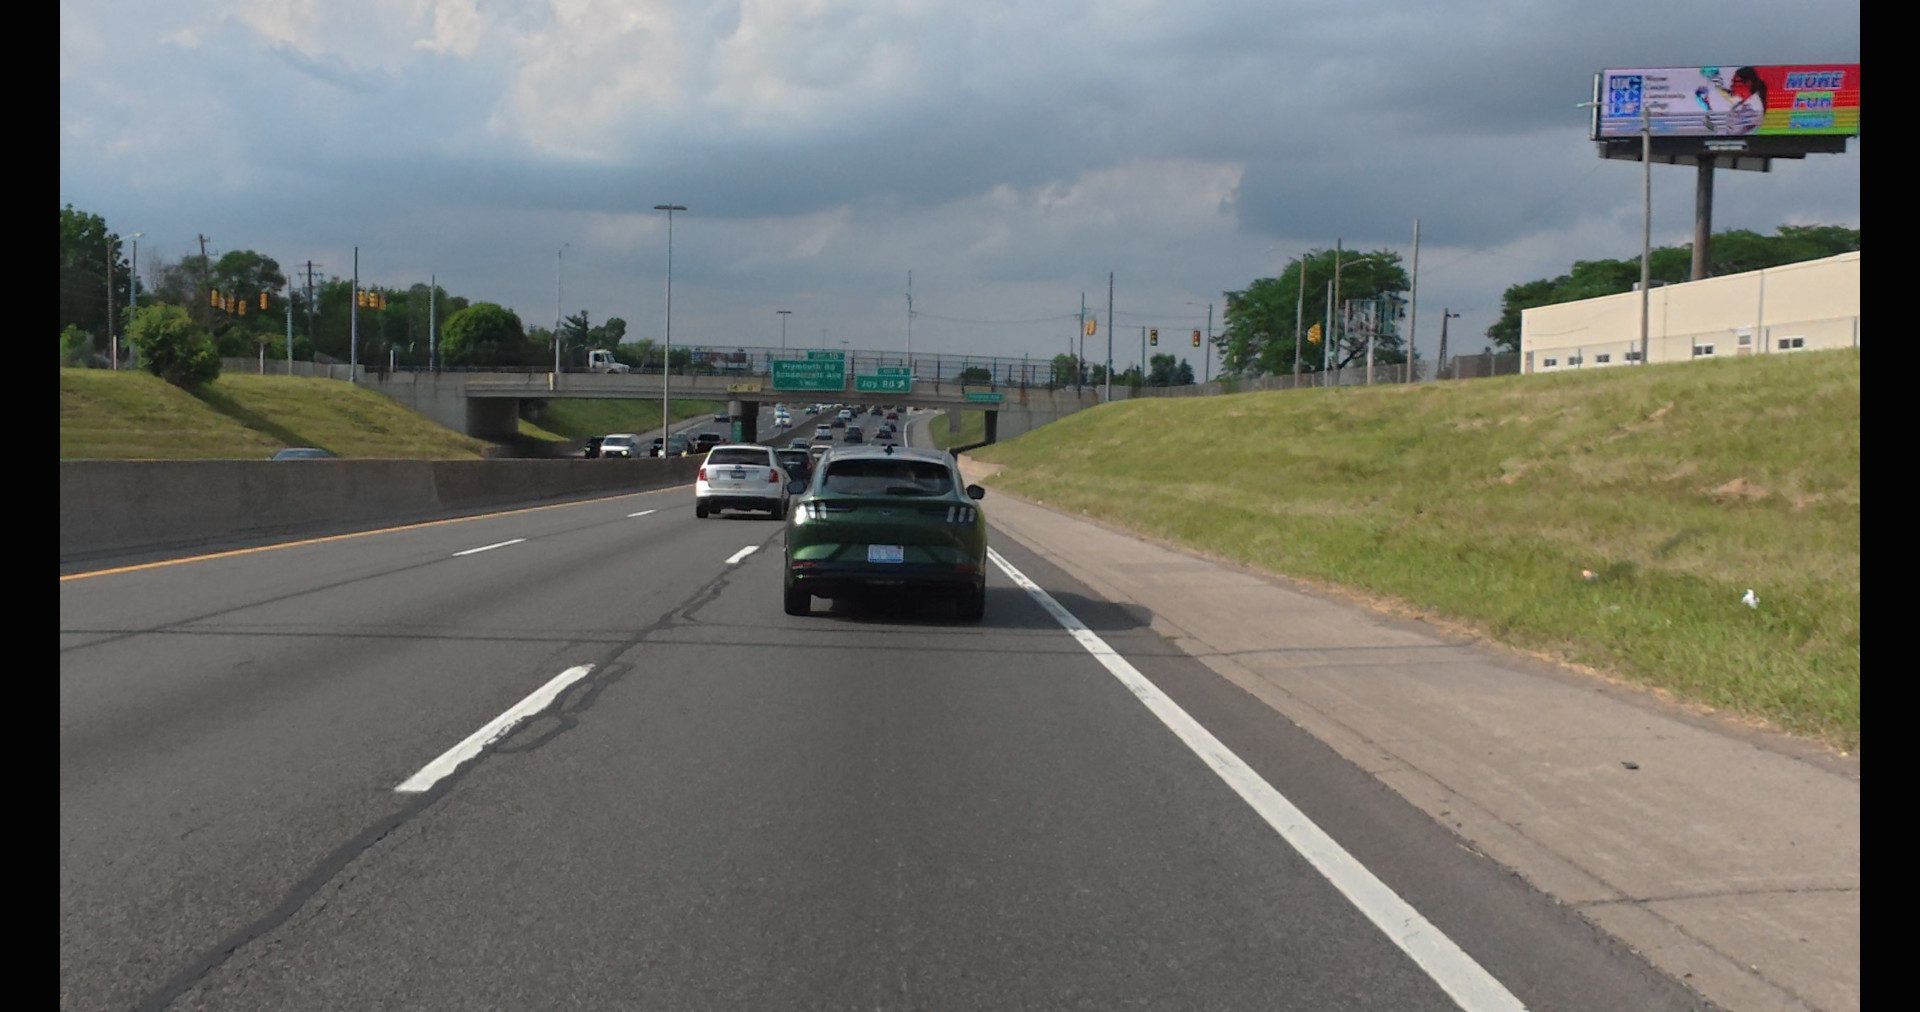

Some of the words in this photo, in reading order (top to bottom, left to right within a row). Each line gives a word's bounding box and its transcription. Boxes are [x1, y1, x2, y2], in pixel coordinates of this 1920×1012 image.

[1784, 71, 1845, 90] MORE
[776, 371, 823, 379] Schooaft
[861, 380, 877, 389] Joy
[882, 380, 895, 388] Rd
